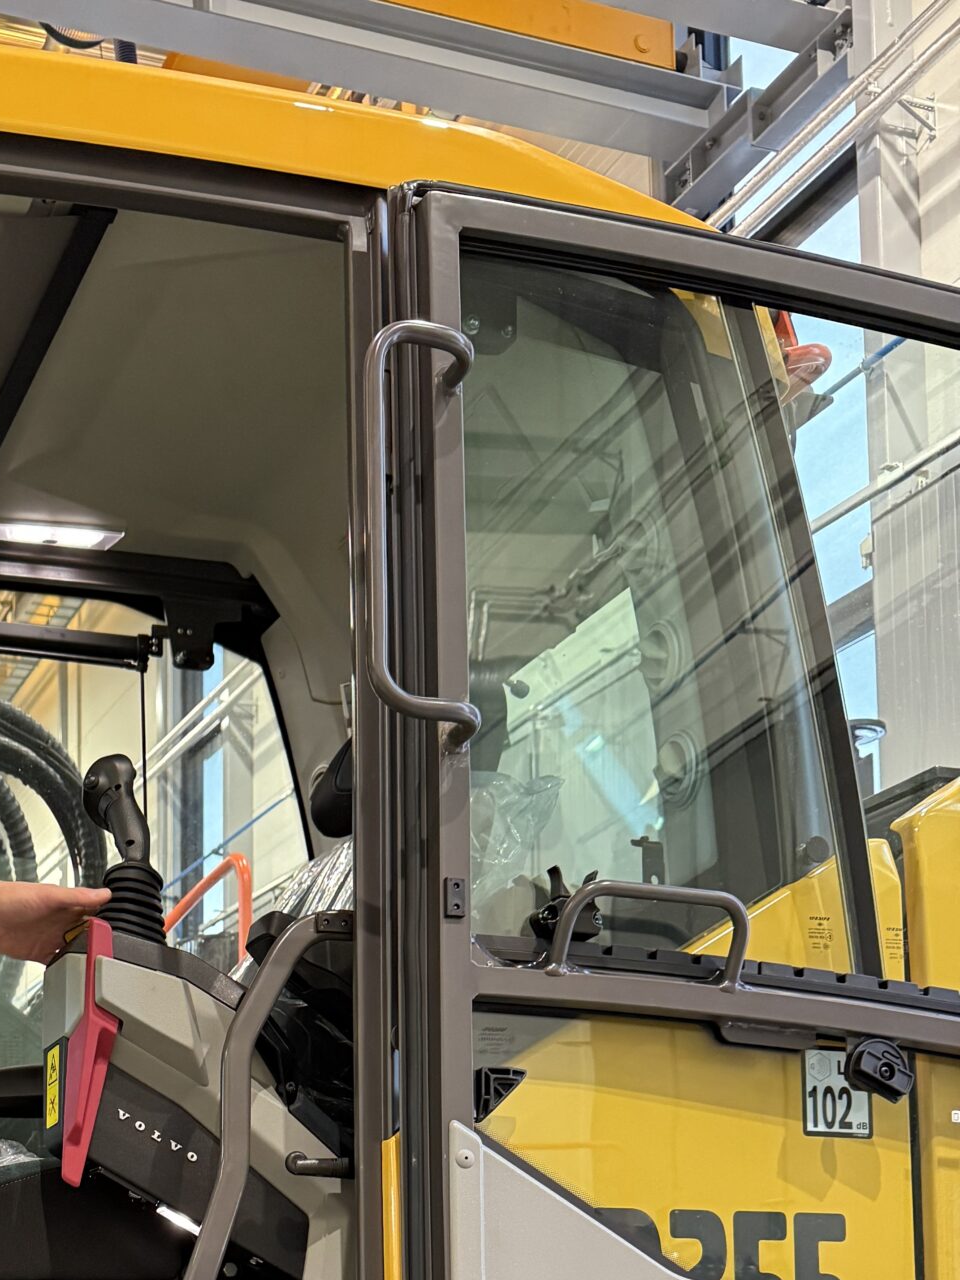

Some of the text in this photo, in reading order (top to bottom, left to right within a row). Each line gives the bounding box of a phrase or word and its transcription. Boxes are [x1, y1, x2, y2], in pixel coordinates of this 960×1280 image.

[808, 1085, 868, 1130] 102 dB
[117, 1108, 198, 1163] VOLVO
